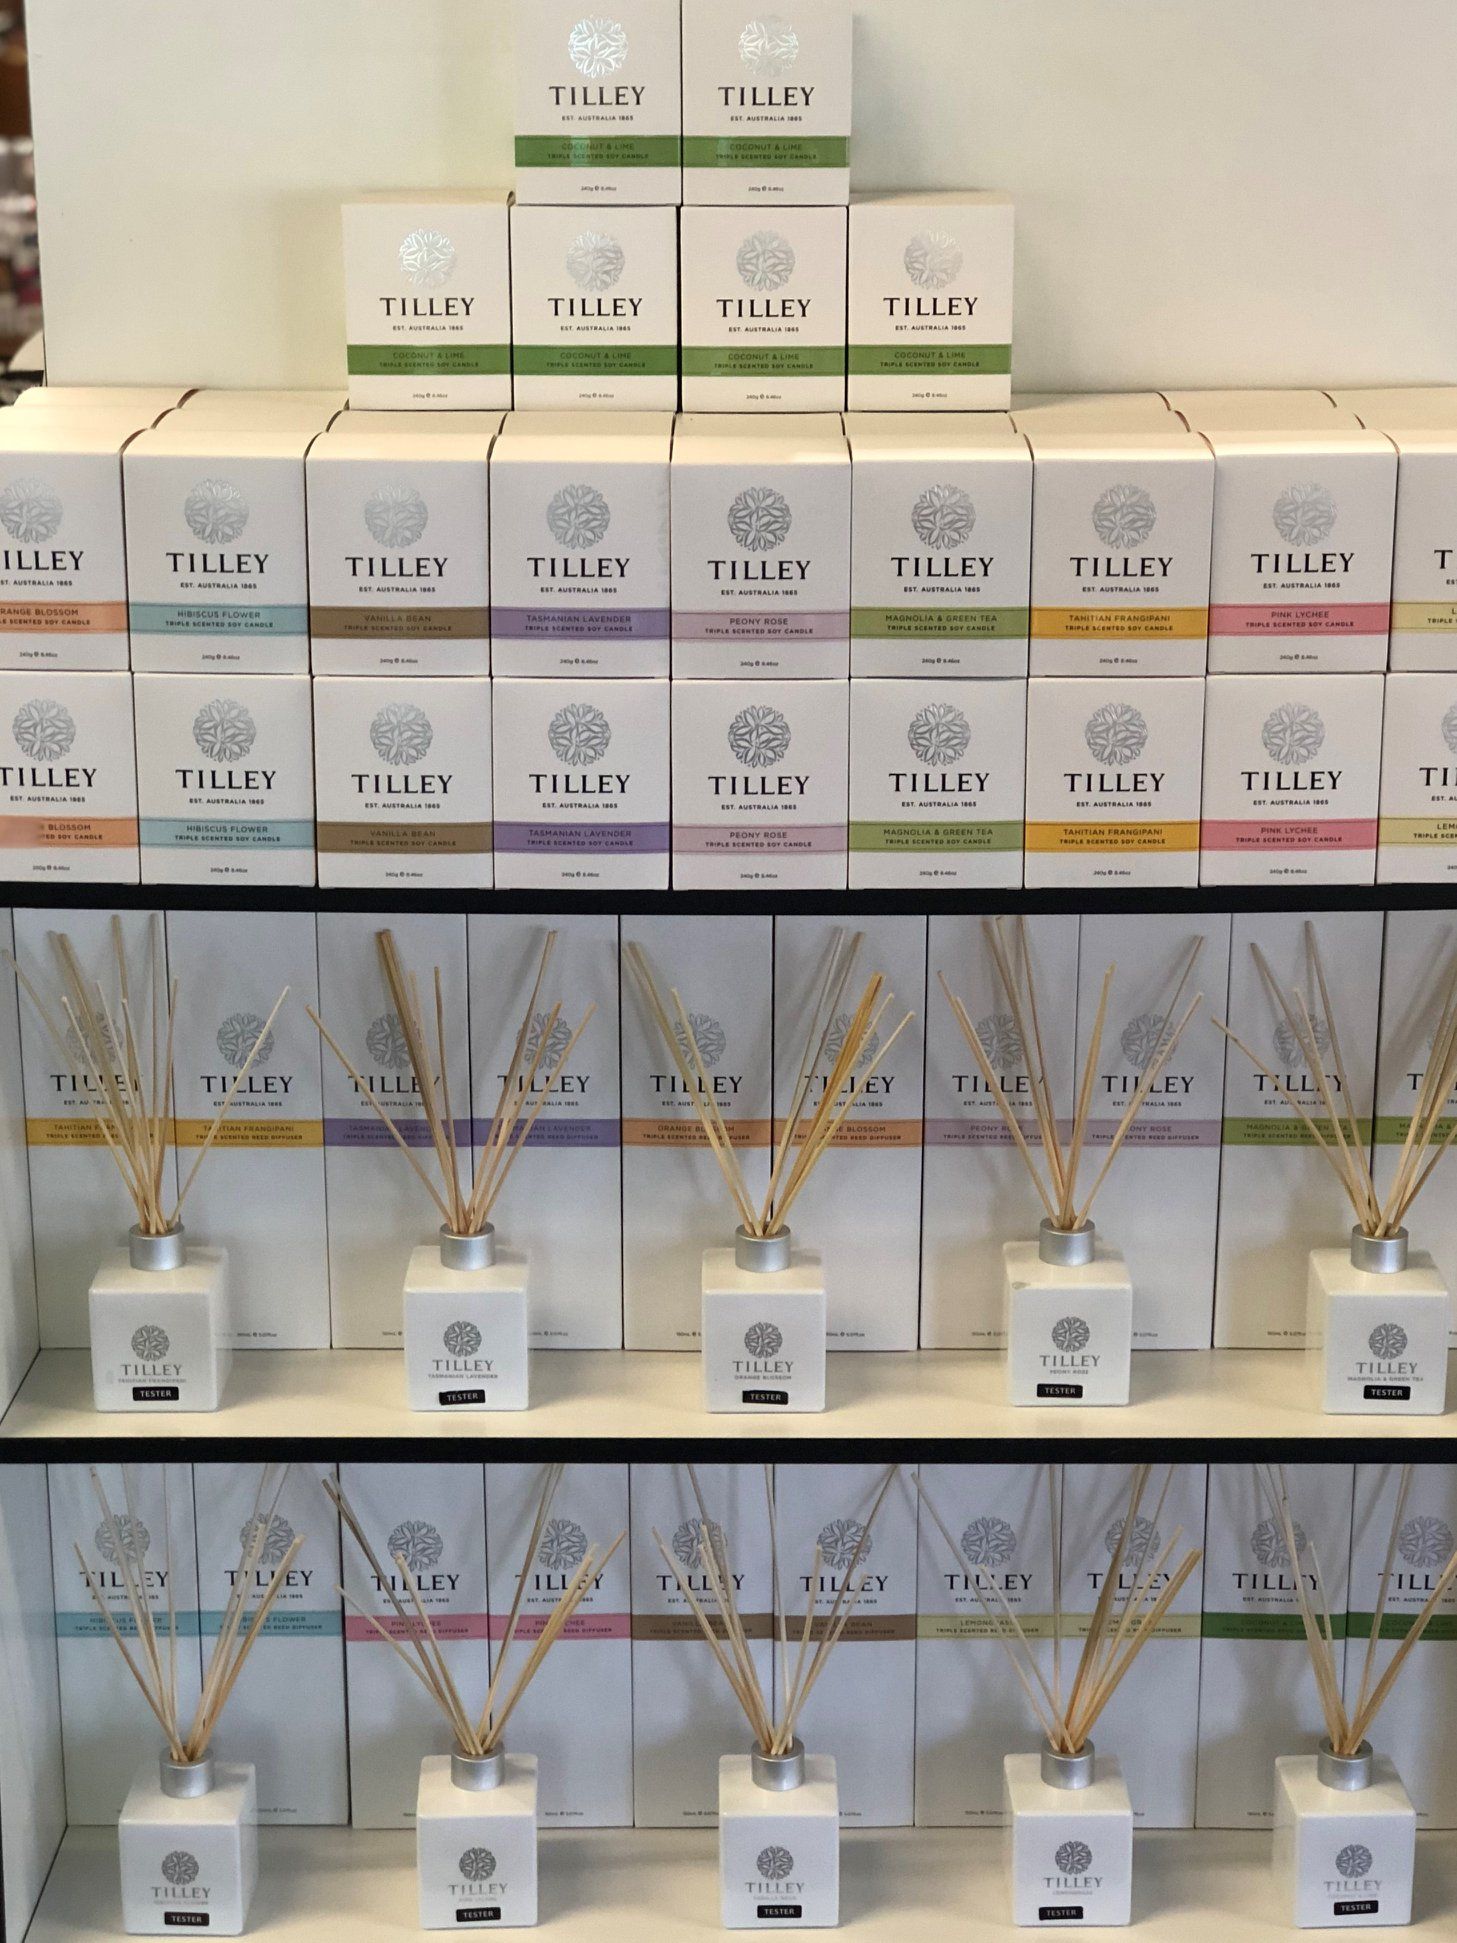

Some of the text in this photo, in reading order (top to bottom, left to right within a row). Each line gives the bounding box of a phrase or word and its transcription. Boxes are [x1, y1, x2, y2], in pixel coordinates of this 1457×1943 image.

[549, 86, 645, 106] TILLEY
[718, 87, 814, 106] TILLEY
[380, 298, 474, 316] TILLEY
[548, 298, 642, 316] TILLEY
[716, 299, 811, 318] TILLEY
[883, 297, 978, 316] TILLEY
[392, 352, 433, 360] COCONUT
[445, 351, 465, 360] LIME
[612, 352, 632, 361] LIME
[4, 550, 84, 570] ILLEY
[166, 553, 268, 573] TILLEY
[345, 557, 448, 577] TILLEY
[527, 558, 630, 578] TILLEY
[891, 557, 994, 577] TILLEY
[1070, 557, 1173, 577] TILLEY
[1251, 553, 1354, 573] TILLEY
[707, 560, 810, 580] TILLEY
[0, 608, 31, 616] RANGE
[177, 610, 219, 619] HIBISCUS
[0, 767, 96, 787] TILLEY
[175, 769, 276, 790] TILLEY
[351, 774, 452, 794] TILLEY
[529, 774, 630, 793] TILLEY
[708, 776, 809, 795] TILLEY
[888, 773, 989, 792] TILLEY
[1064, 773, 1165, 792] TILLEY
[1241, 771, 1342, 790] TILLEY
[121, 1364, 182, 1376] TILLEY
[432, 1360, 493, 1371] TILLEY
[732, 1361, 793, 1373] TILLEY
[1039, 1355, 1100, 1367] TILLEY
[1356, 1362, 1418, 1374] TILLEY
[140, 1390, 171, 1400] TESTER
[447, 1392, 478, 1401] TESTER
[751, 1393, 781, 1401] TESTER
[1045, 1387, 1076, 1395] TESTER
[448, 1881, 508, 1895] TILLEY
[745, 1880, 804, 1893] TILLEY
[1043, 1874, 1103, 1888] TILLEY
[1323, 1878, 1382, 1891] TILLEY
[151, 1884, 210, 1898] TILLEY
[464, 1910, 494, 1918] TESTER
[1341, 1903, 1371, 1912] TESTER
